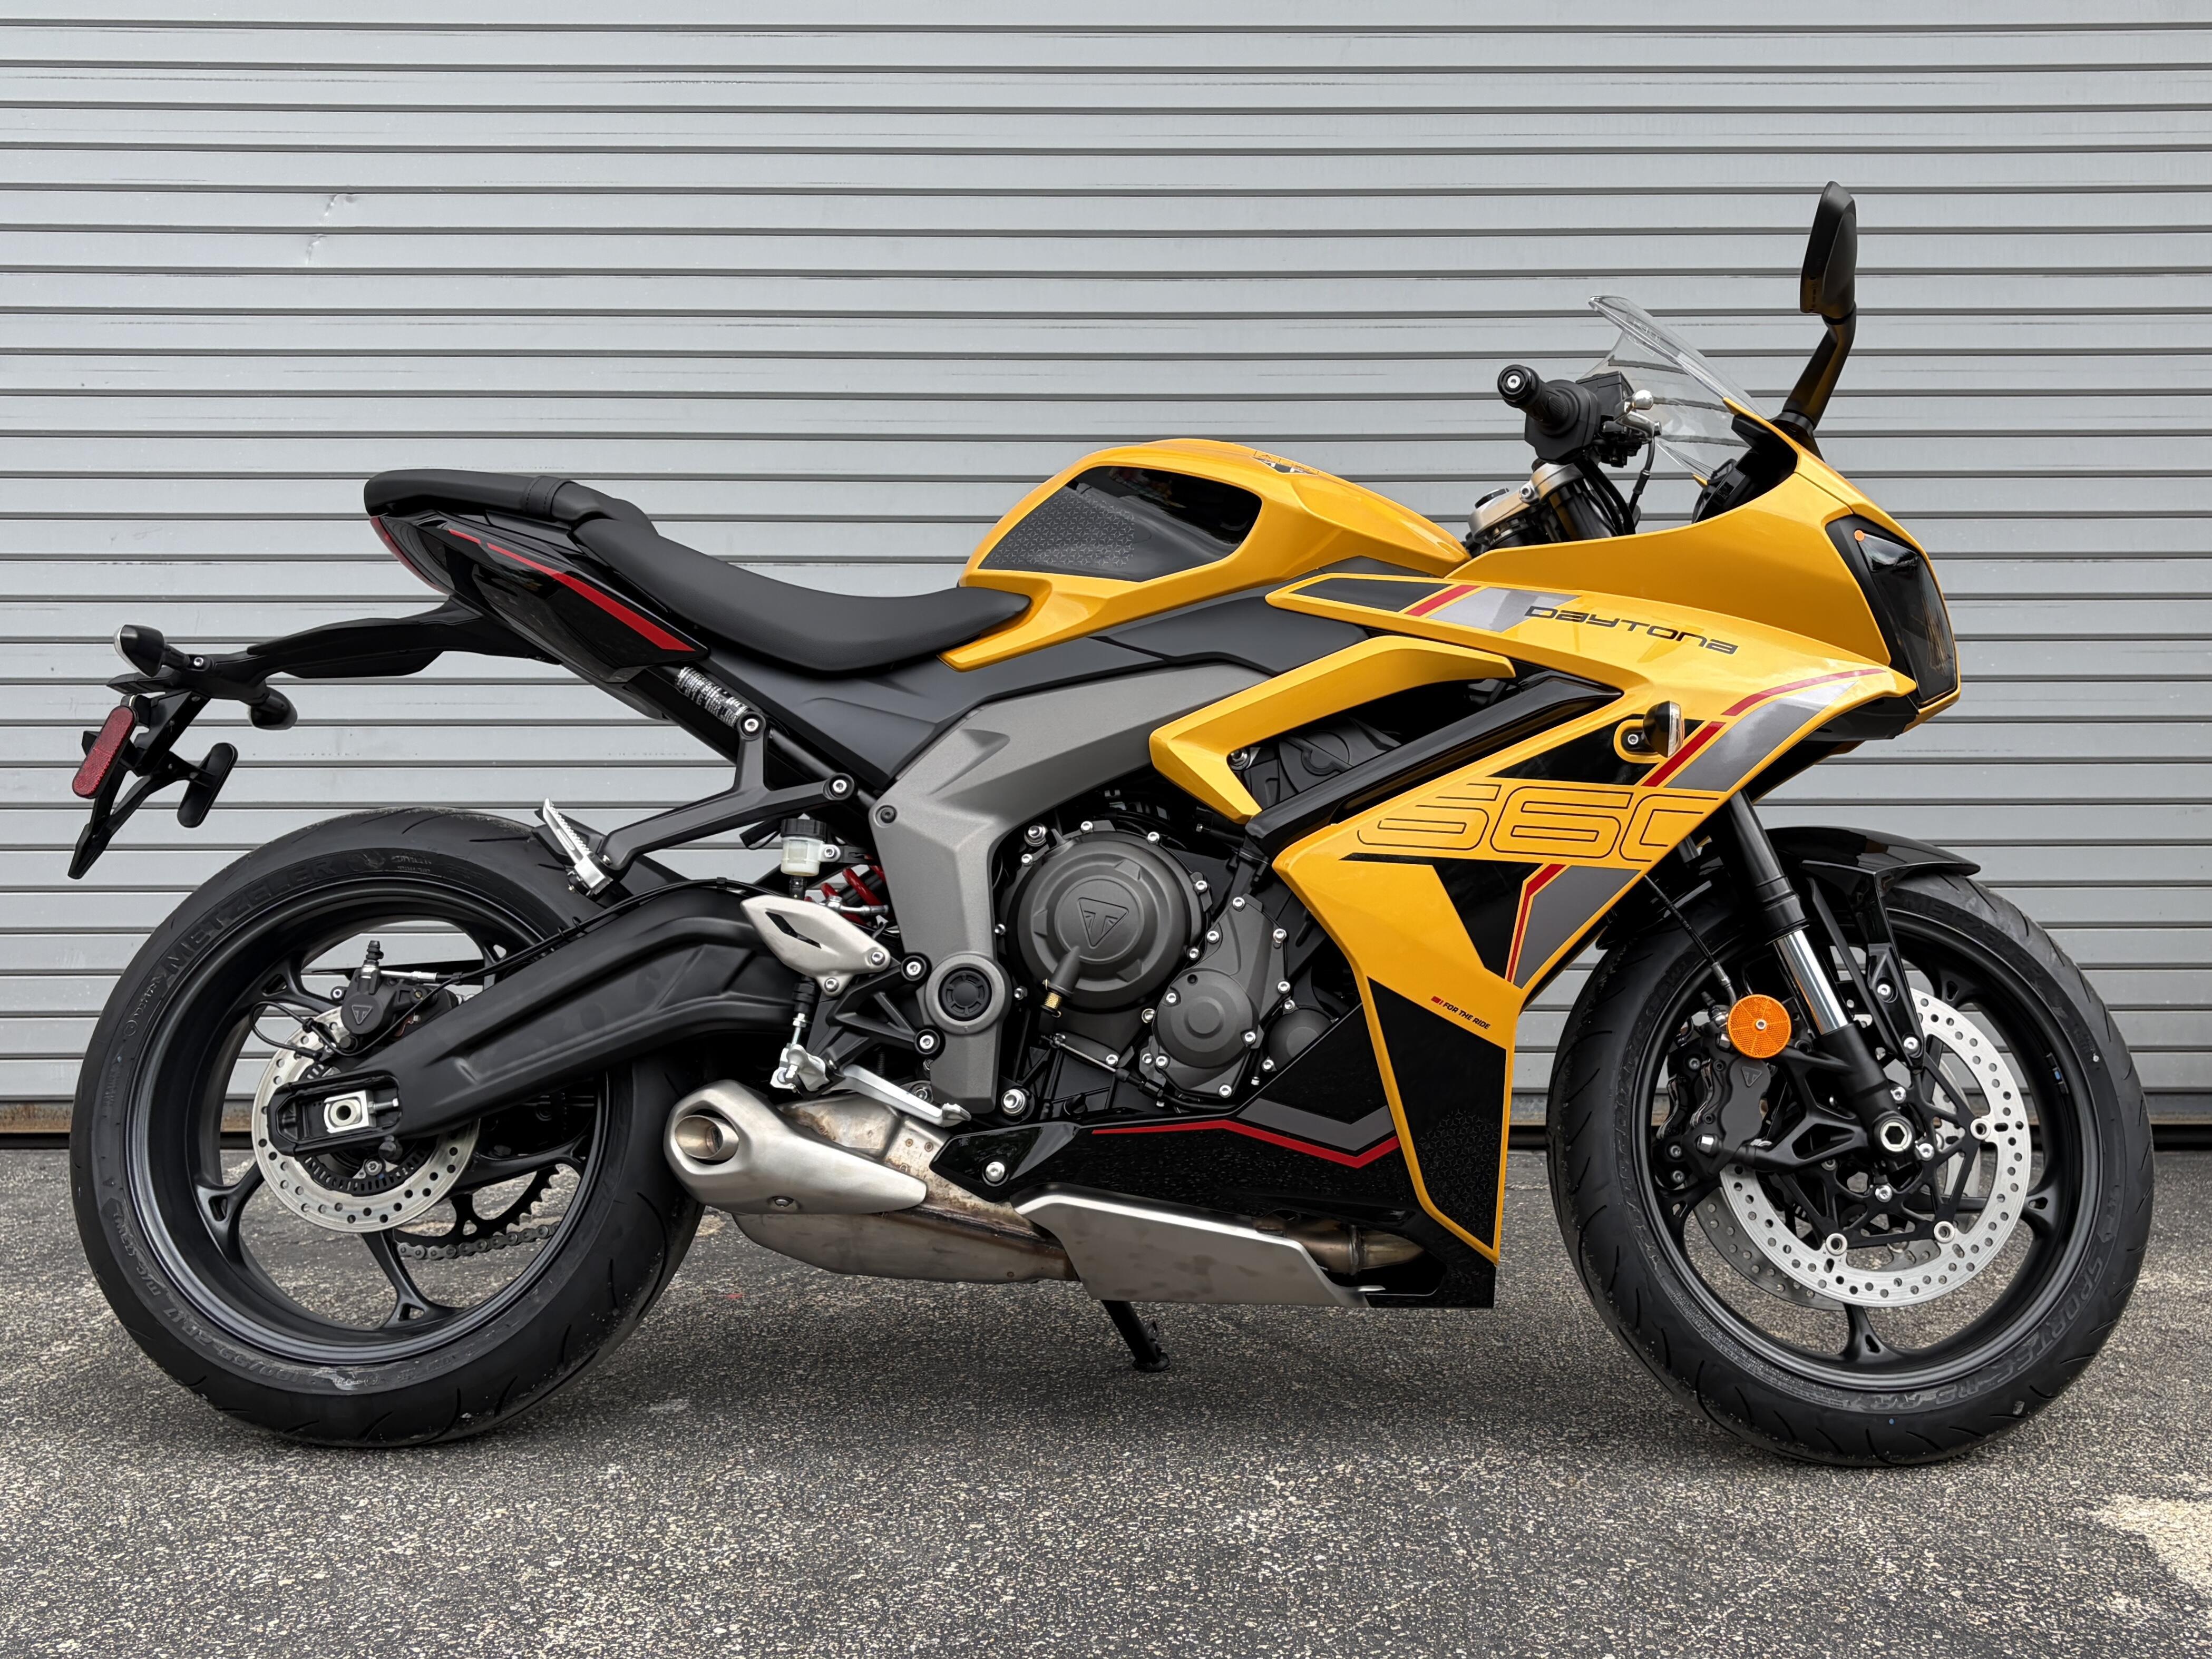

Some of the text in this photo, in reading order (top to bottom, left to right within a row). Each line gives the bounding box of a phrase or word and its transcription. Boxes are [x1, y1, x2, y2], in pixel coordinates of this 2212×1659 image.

[158, 858, 336, 977] METZELER
[1443, 1002, 1490, 1029] FOR THE RIDE
[1991, 1254, 2104, 1382] SPORTEC
